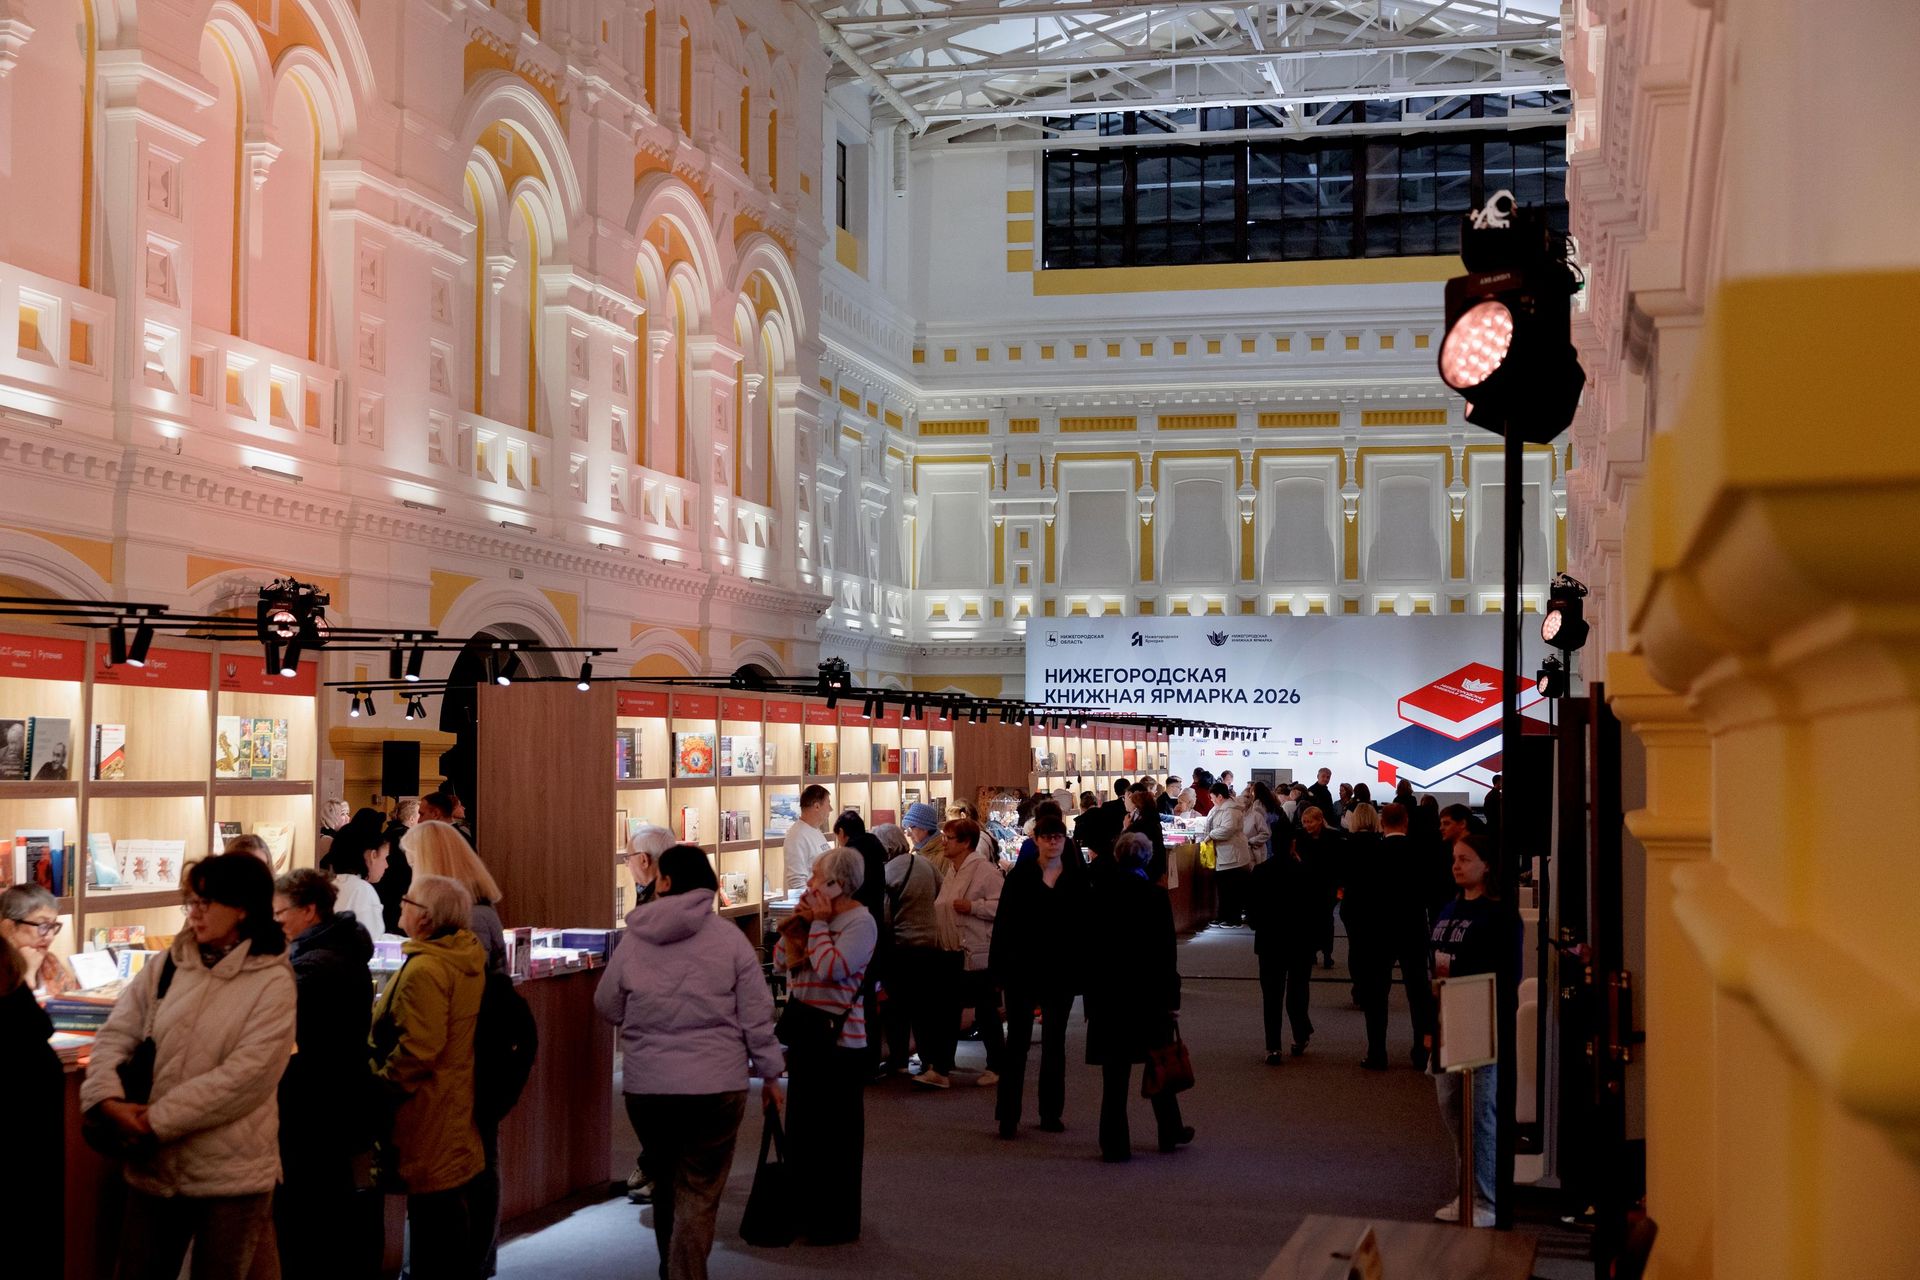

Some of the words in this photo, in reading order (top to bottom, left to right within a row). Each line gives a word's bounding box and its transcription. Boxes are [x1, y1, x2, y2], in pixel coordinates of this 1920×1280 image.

[1045, 668, 1226, 685] НИЖЕГОРОДСКАЯ
[1045, 689, 1145, 704] КНИЖНАЯ
[1151, 689, 1248, 704] ЯРМАРКА
[1253, 689, 1301, 704] 2026
